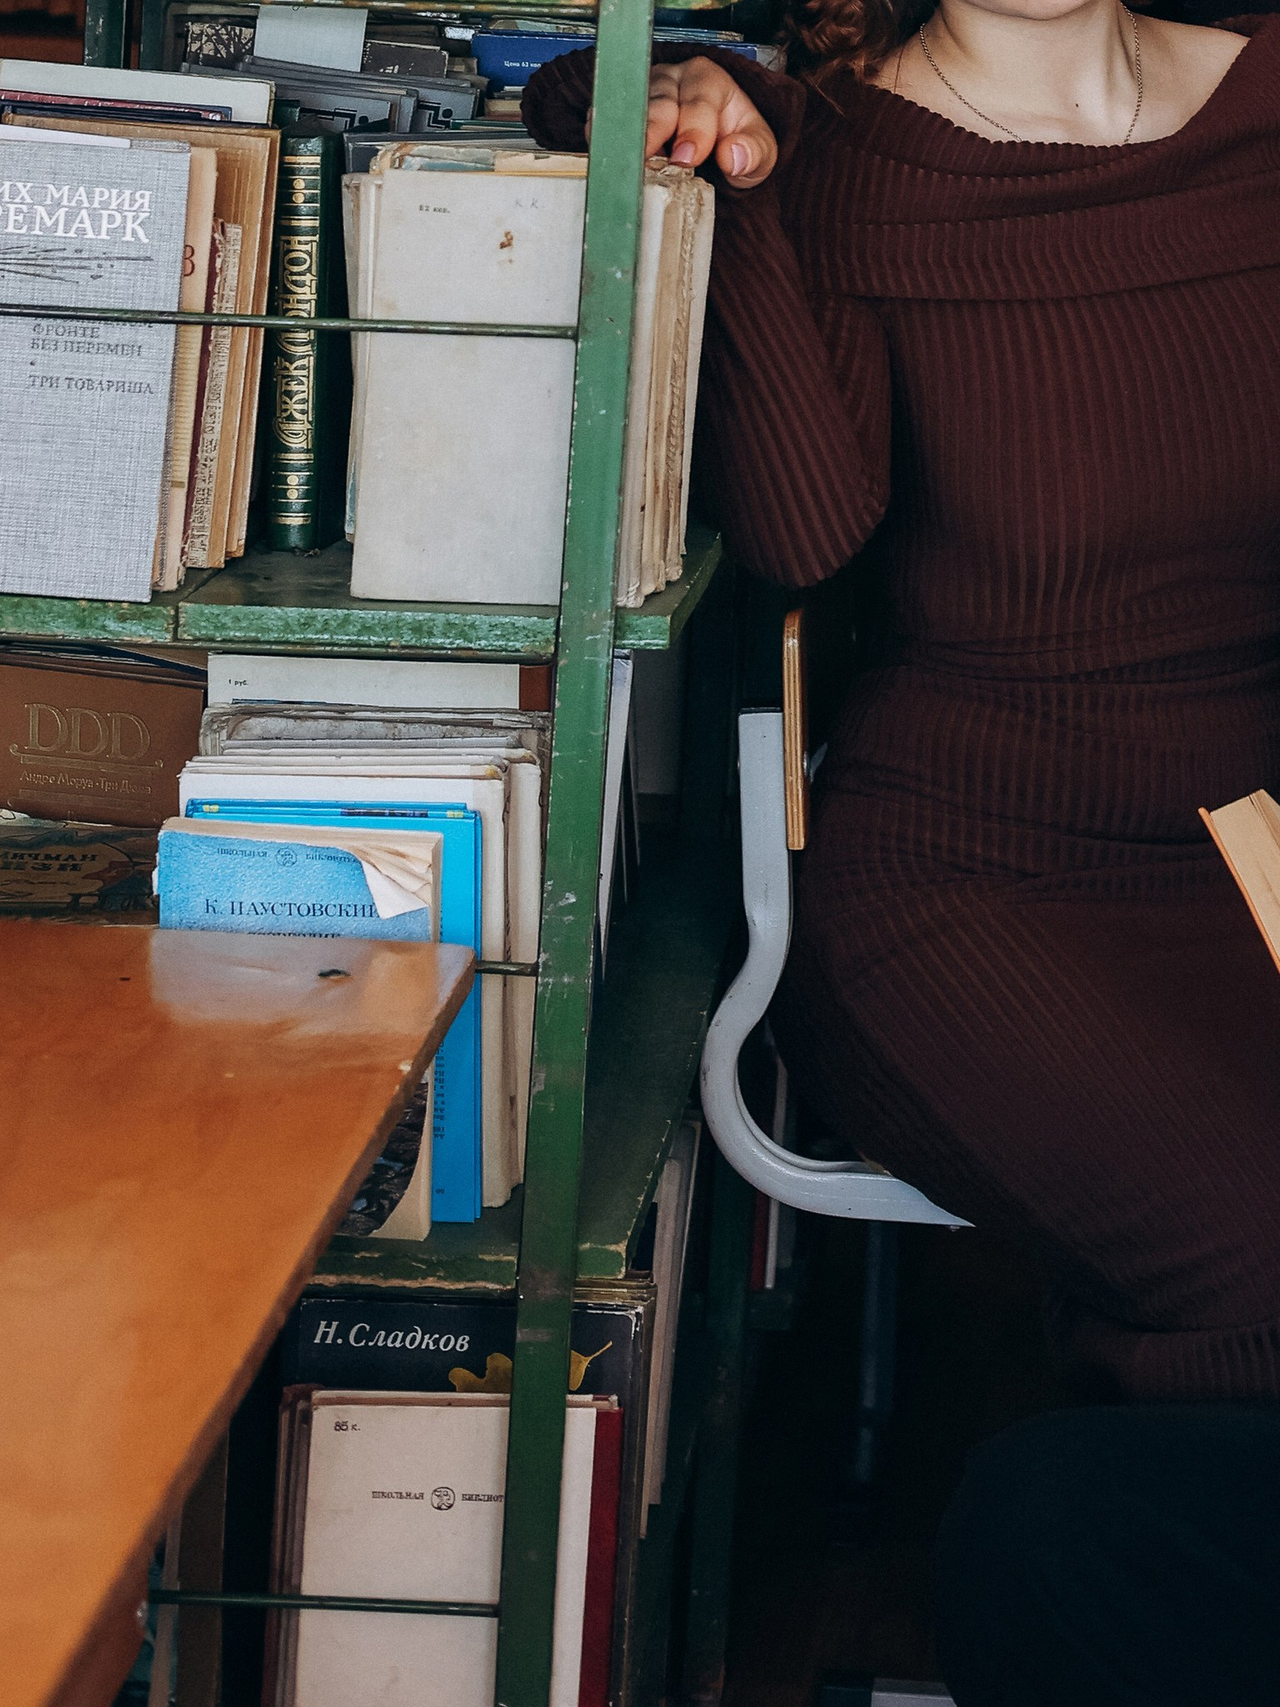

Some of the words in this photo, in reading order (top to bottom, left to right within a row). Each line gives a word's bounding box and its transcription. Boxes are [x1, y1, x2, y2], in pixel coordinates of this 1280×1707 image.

[46, 183, 152, 212] МАРИЯ
[0, 203, 150, 243] ЕМАРК
[33, 323, 100, 339] ФРОНТЕ
[31, 338, 60, 352] БЕЗ
[62, 340, 142, 357] ПЕРЕМЕН
[29, 375, 60, 389] ТРИ
[24, 702, 152, 761] DDD
[20, 770, 55, 785] Андре
[57, 772, 94, 789] Моруа
[205, 898, 222, 916] К.
[349, 1322, 470, 1352] Сладков
[372, 1490, 424, 1501] ШКОЛЬНАЯ
